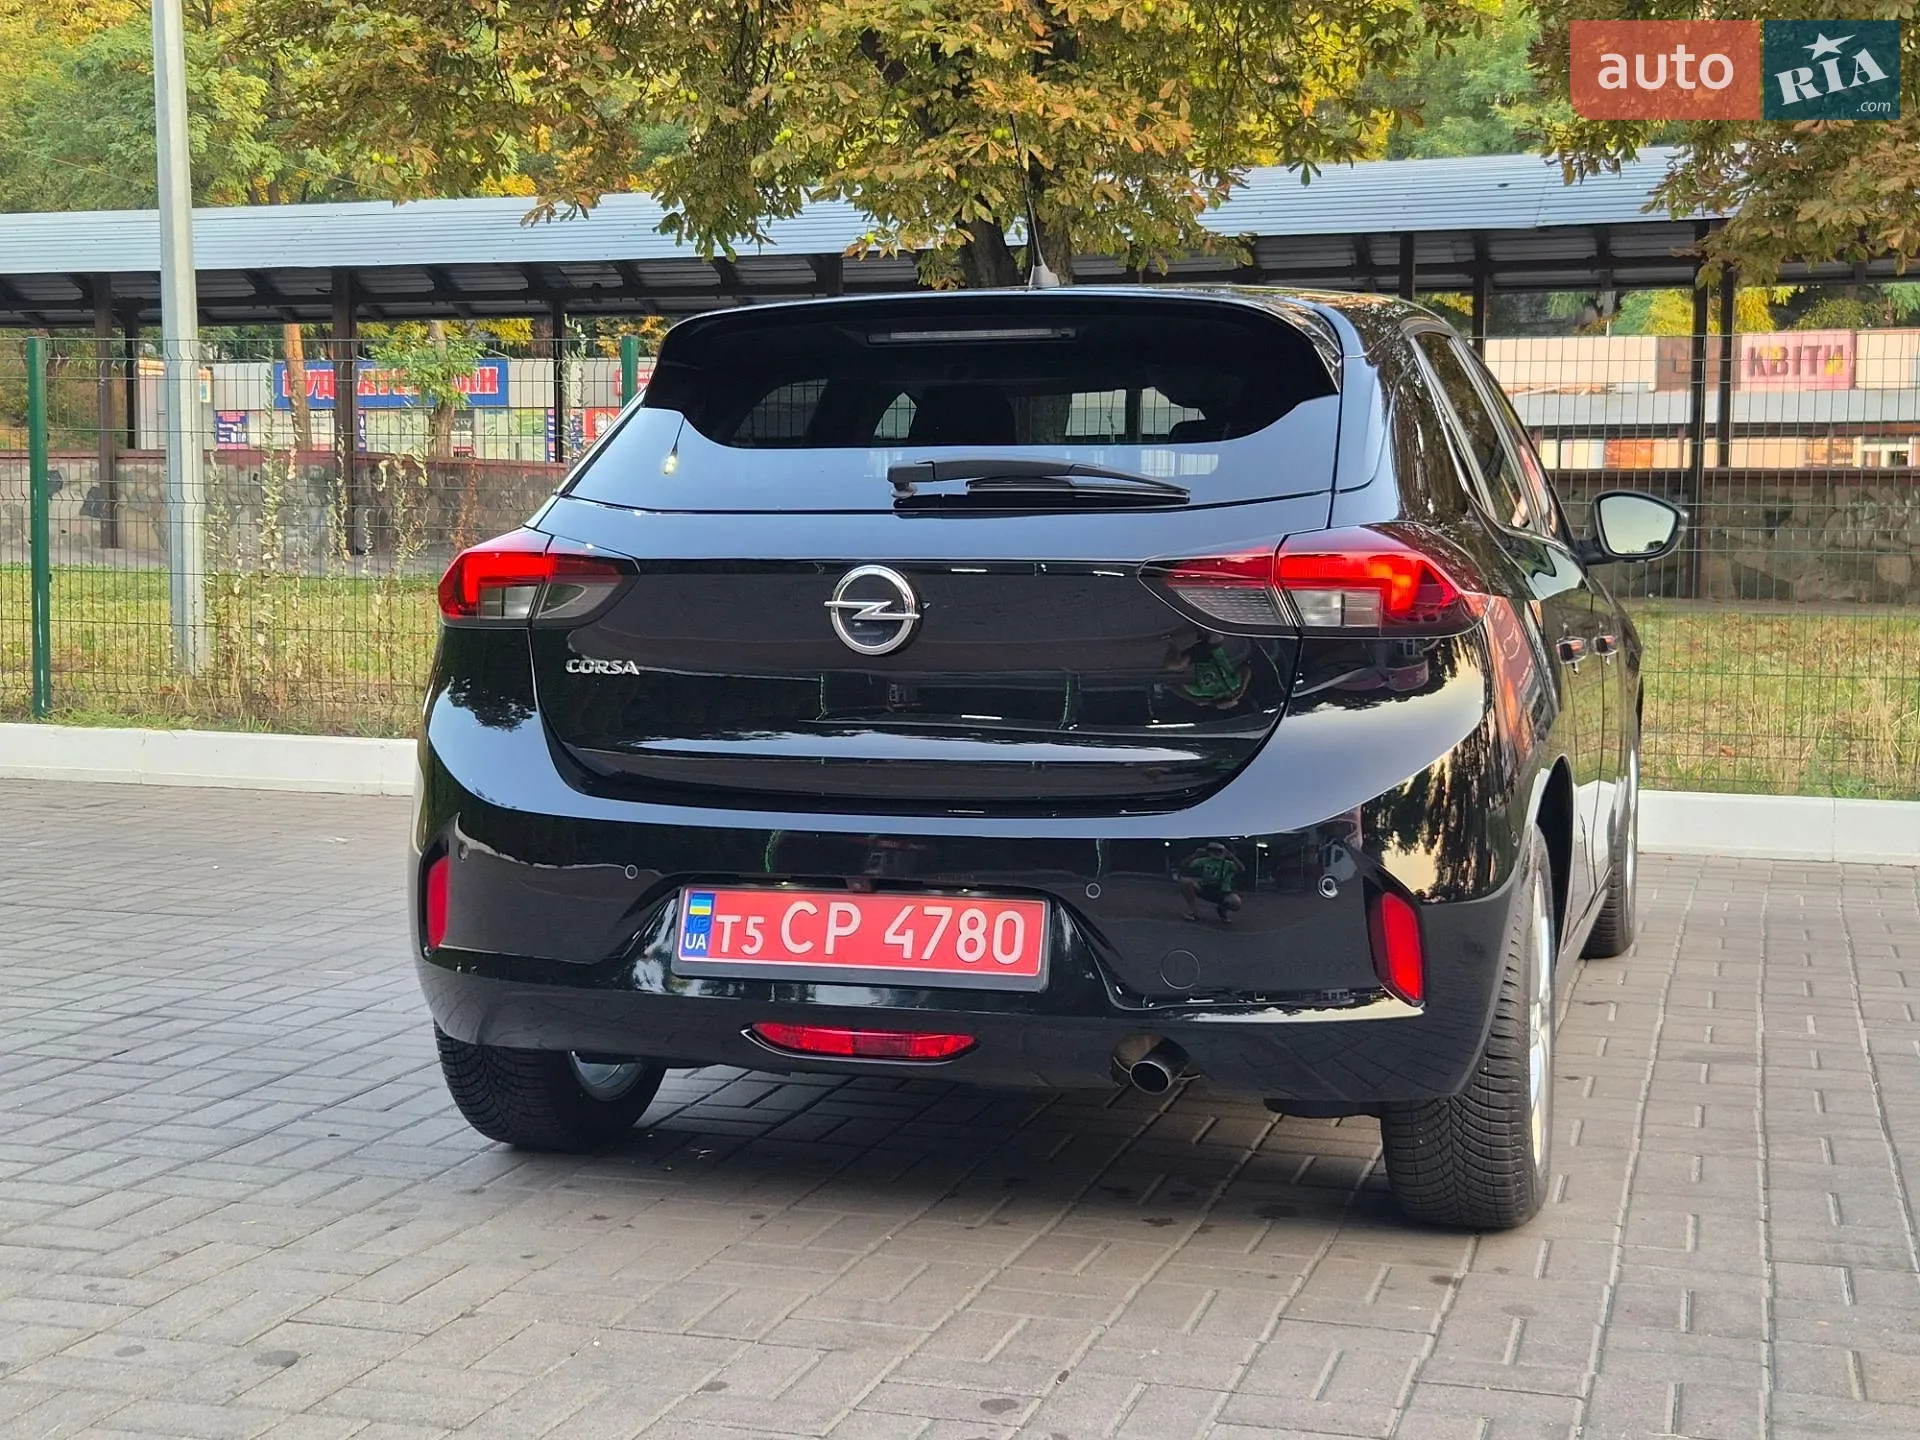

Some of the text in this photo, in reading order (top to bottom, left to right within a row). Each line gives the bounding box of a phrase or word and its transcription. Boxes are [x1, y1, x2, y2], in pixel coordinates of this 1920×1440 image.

[565, 658, 640, 675] CORSA
[685, 933, 706, 950] UA
[883, 904, 1025, 965] 4780
